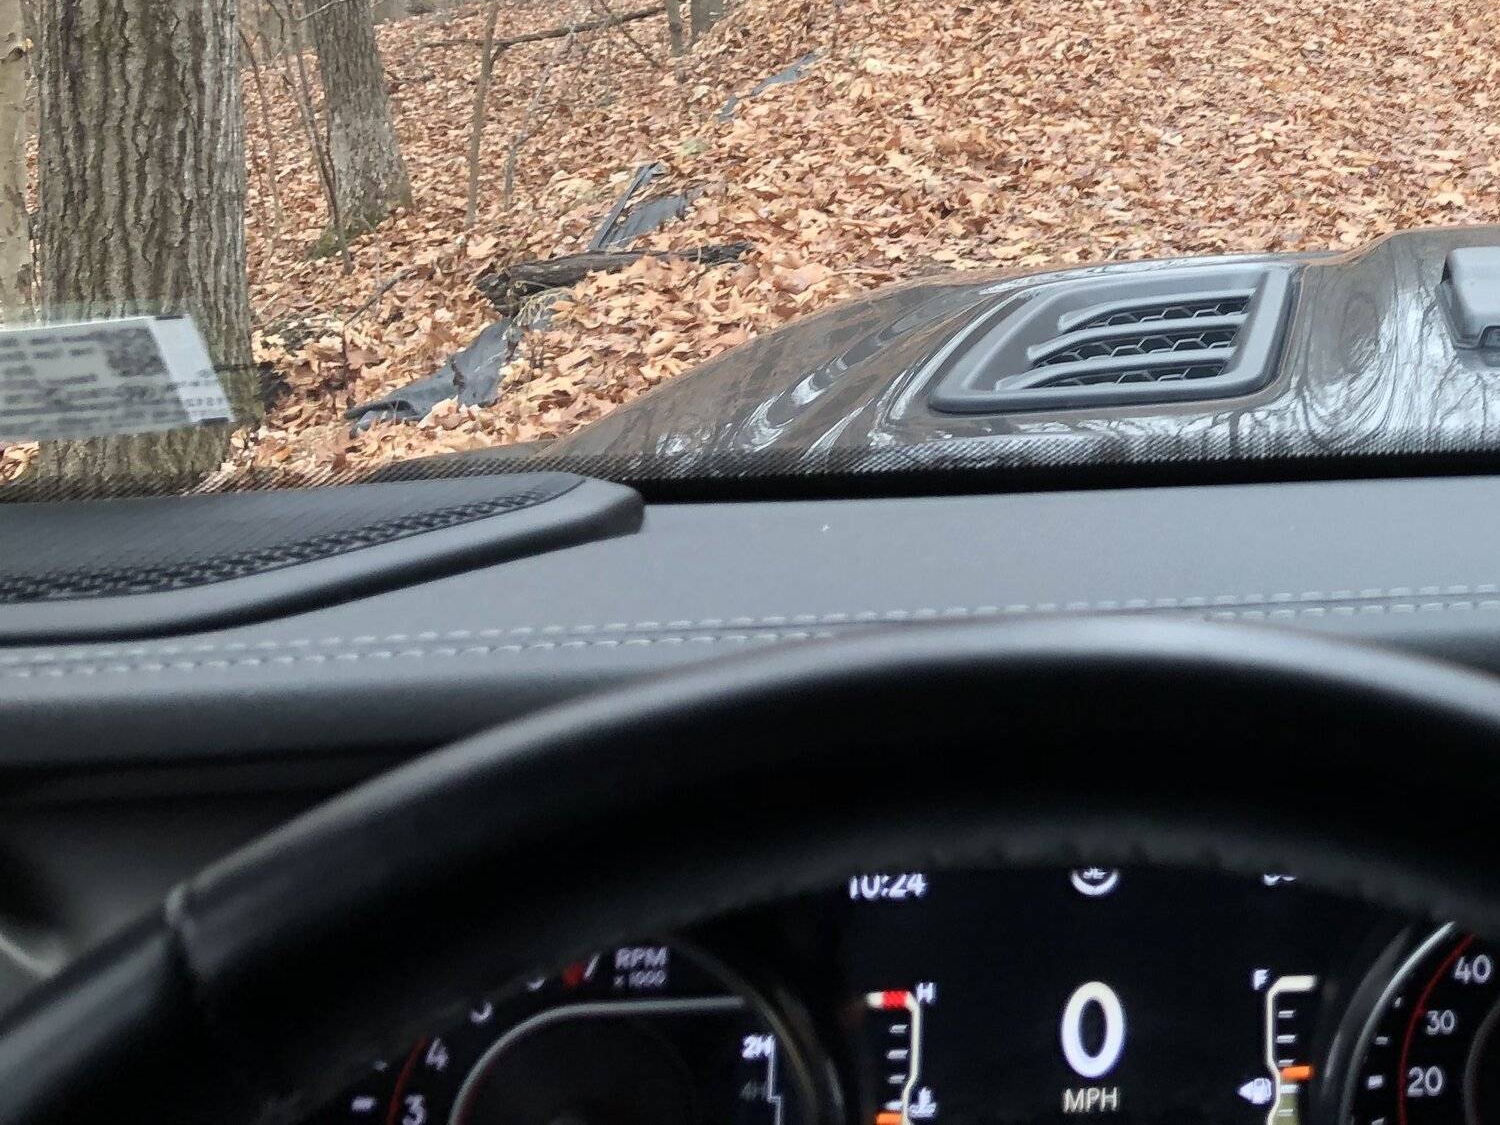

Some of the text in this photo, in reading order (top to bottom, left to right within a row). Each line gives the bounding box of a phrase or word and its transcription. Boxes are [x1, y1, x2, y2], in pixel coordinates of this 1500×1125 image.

[849, 872, 928, 901] 10:24
[614, 946, 667, 970] RPM
[1454, 954, 1492, 984] 40
[915, 981, 937, 1003] H
[1253, 968, 1270, 991] F
[1060, 981, 1127, 1079] 0
[1426, 1009, 1456, 1035] 30
[425, 1037, 449, 1071] 4
[1407, 1065, 1444, 1096] 20
[402, 1093, 428, 1125] 3
[1062, 1086, 1119, 1113] MPH
